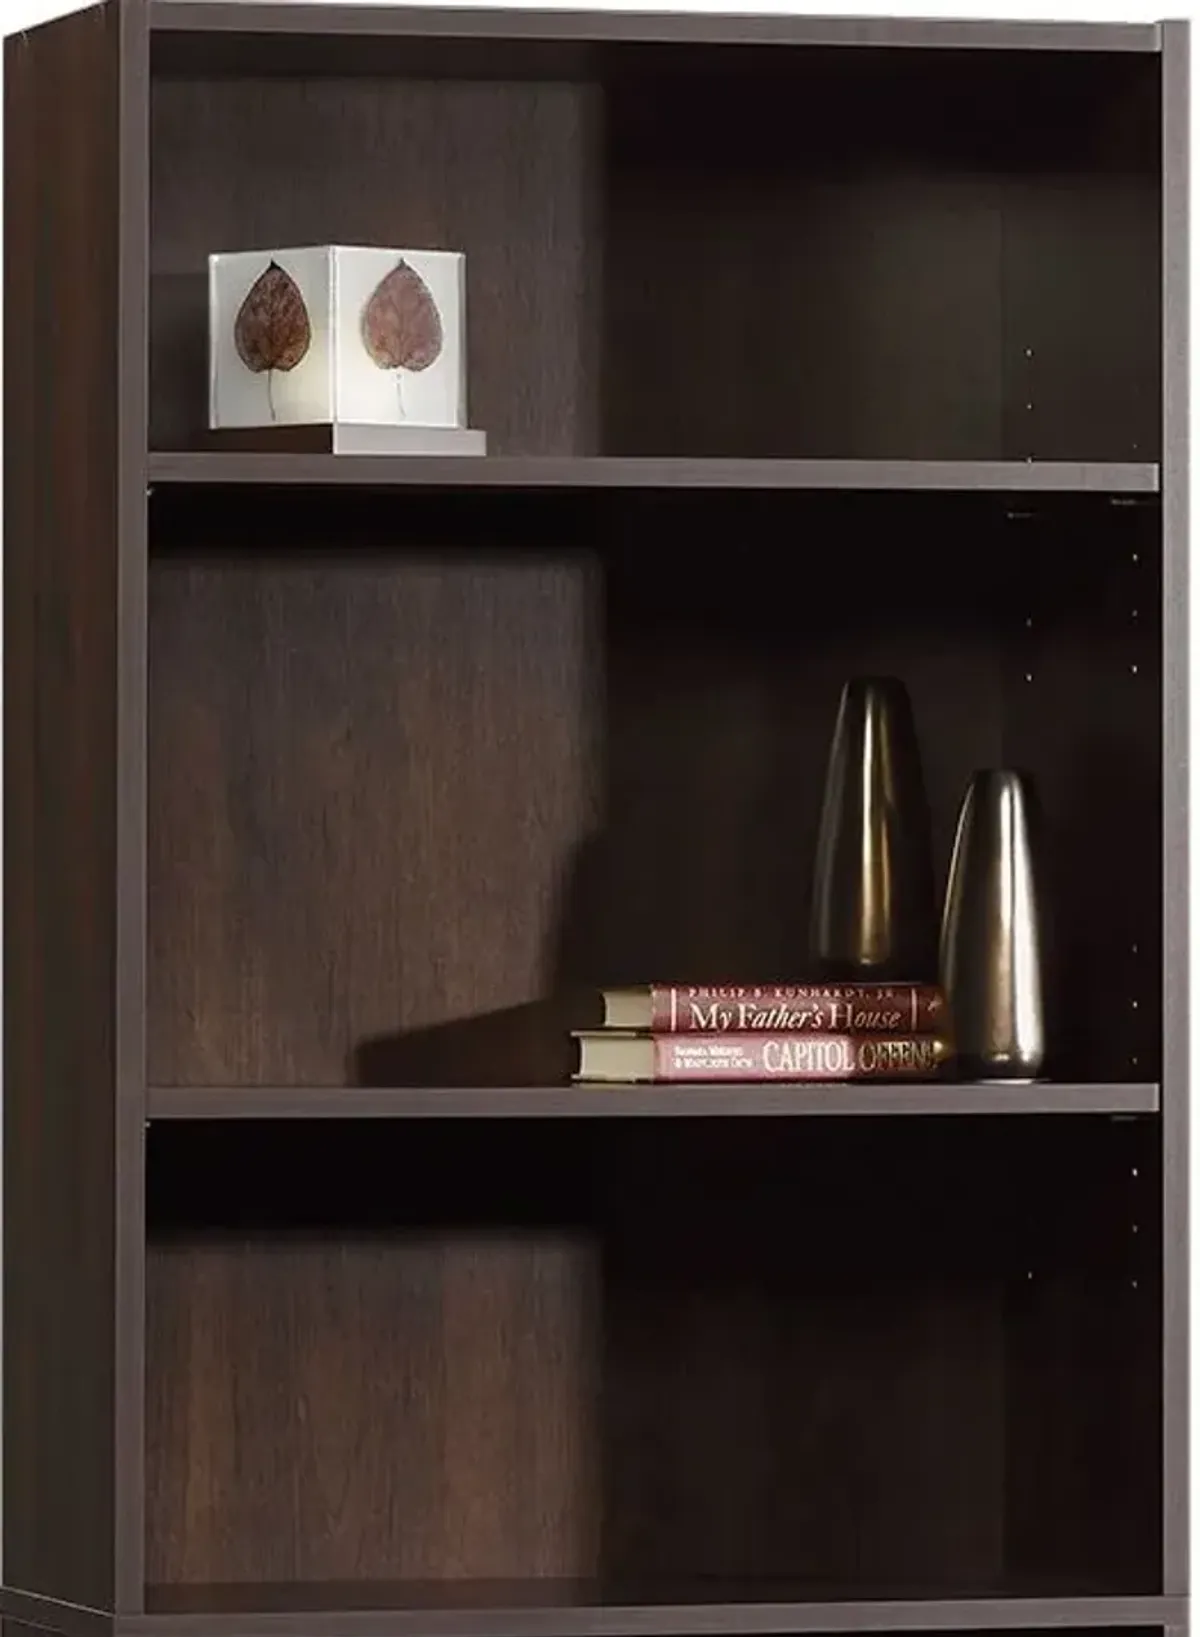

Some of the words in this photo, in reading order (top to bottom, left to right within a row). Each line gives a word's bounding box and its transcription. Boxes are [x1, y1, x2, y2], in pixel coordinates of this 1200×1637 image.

[688, 987, 745, 998] PHILIP
[689, 1003, 733, 1030] My
[737, 1002, 825, 1030] Father's
[827, 1003, 902, 1030] House
[762, 1041, 856, 1072] CAPITOL
